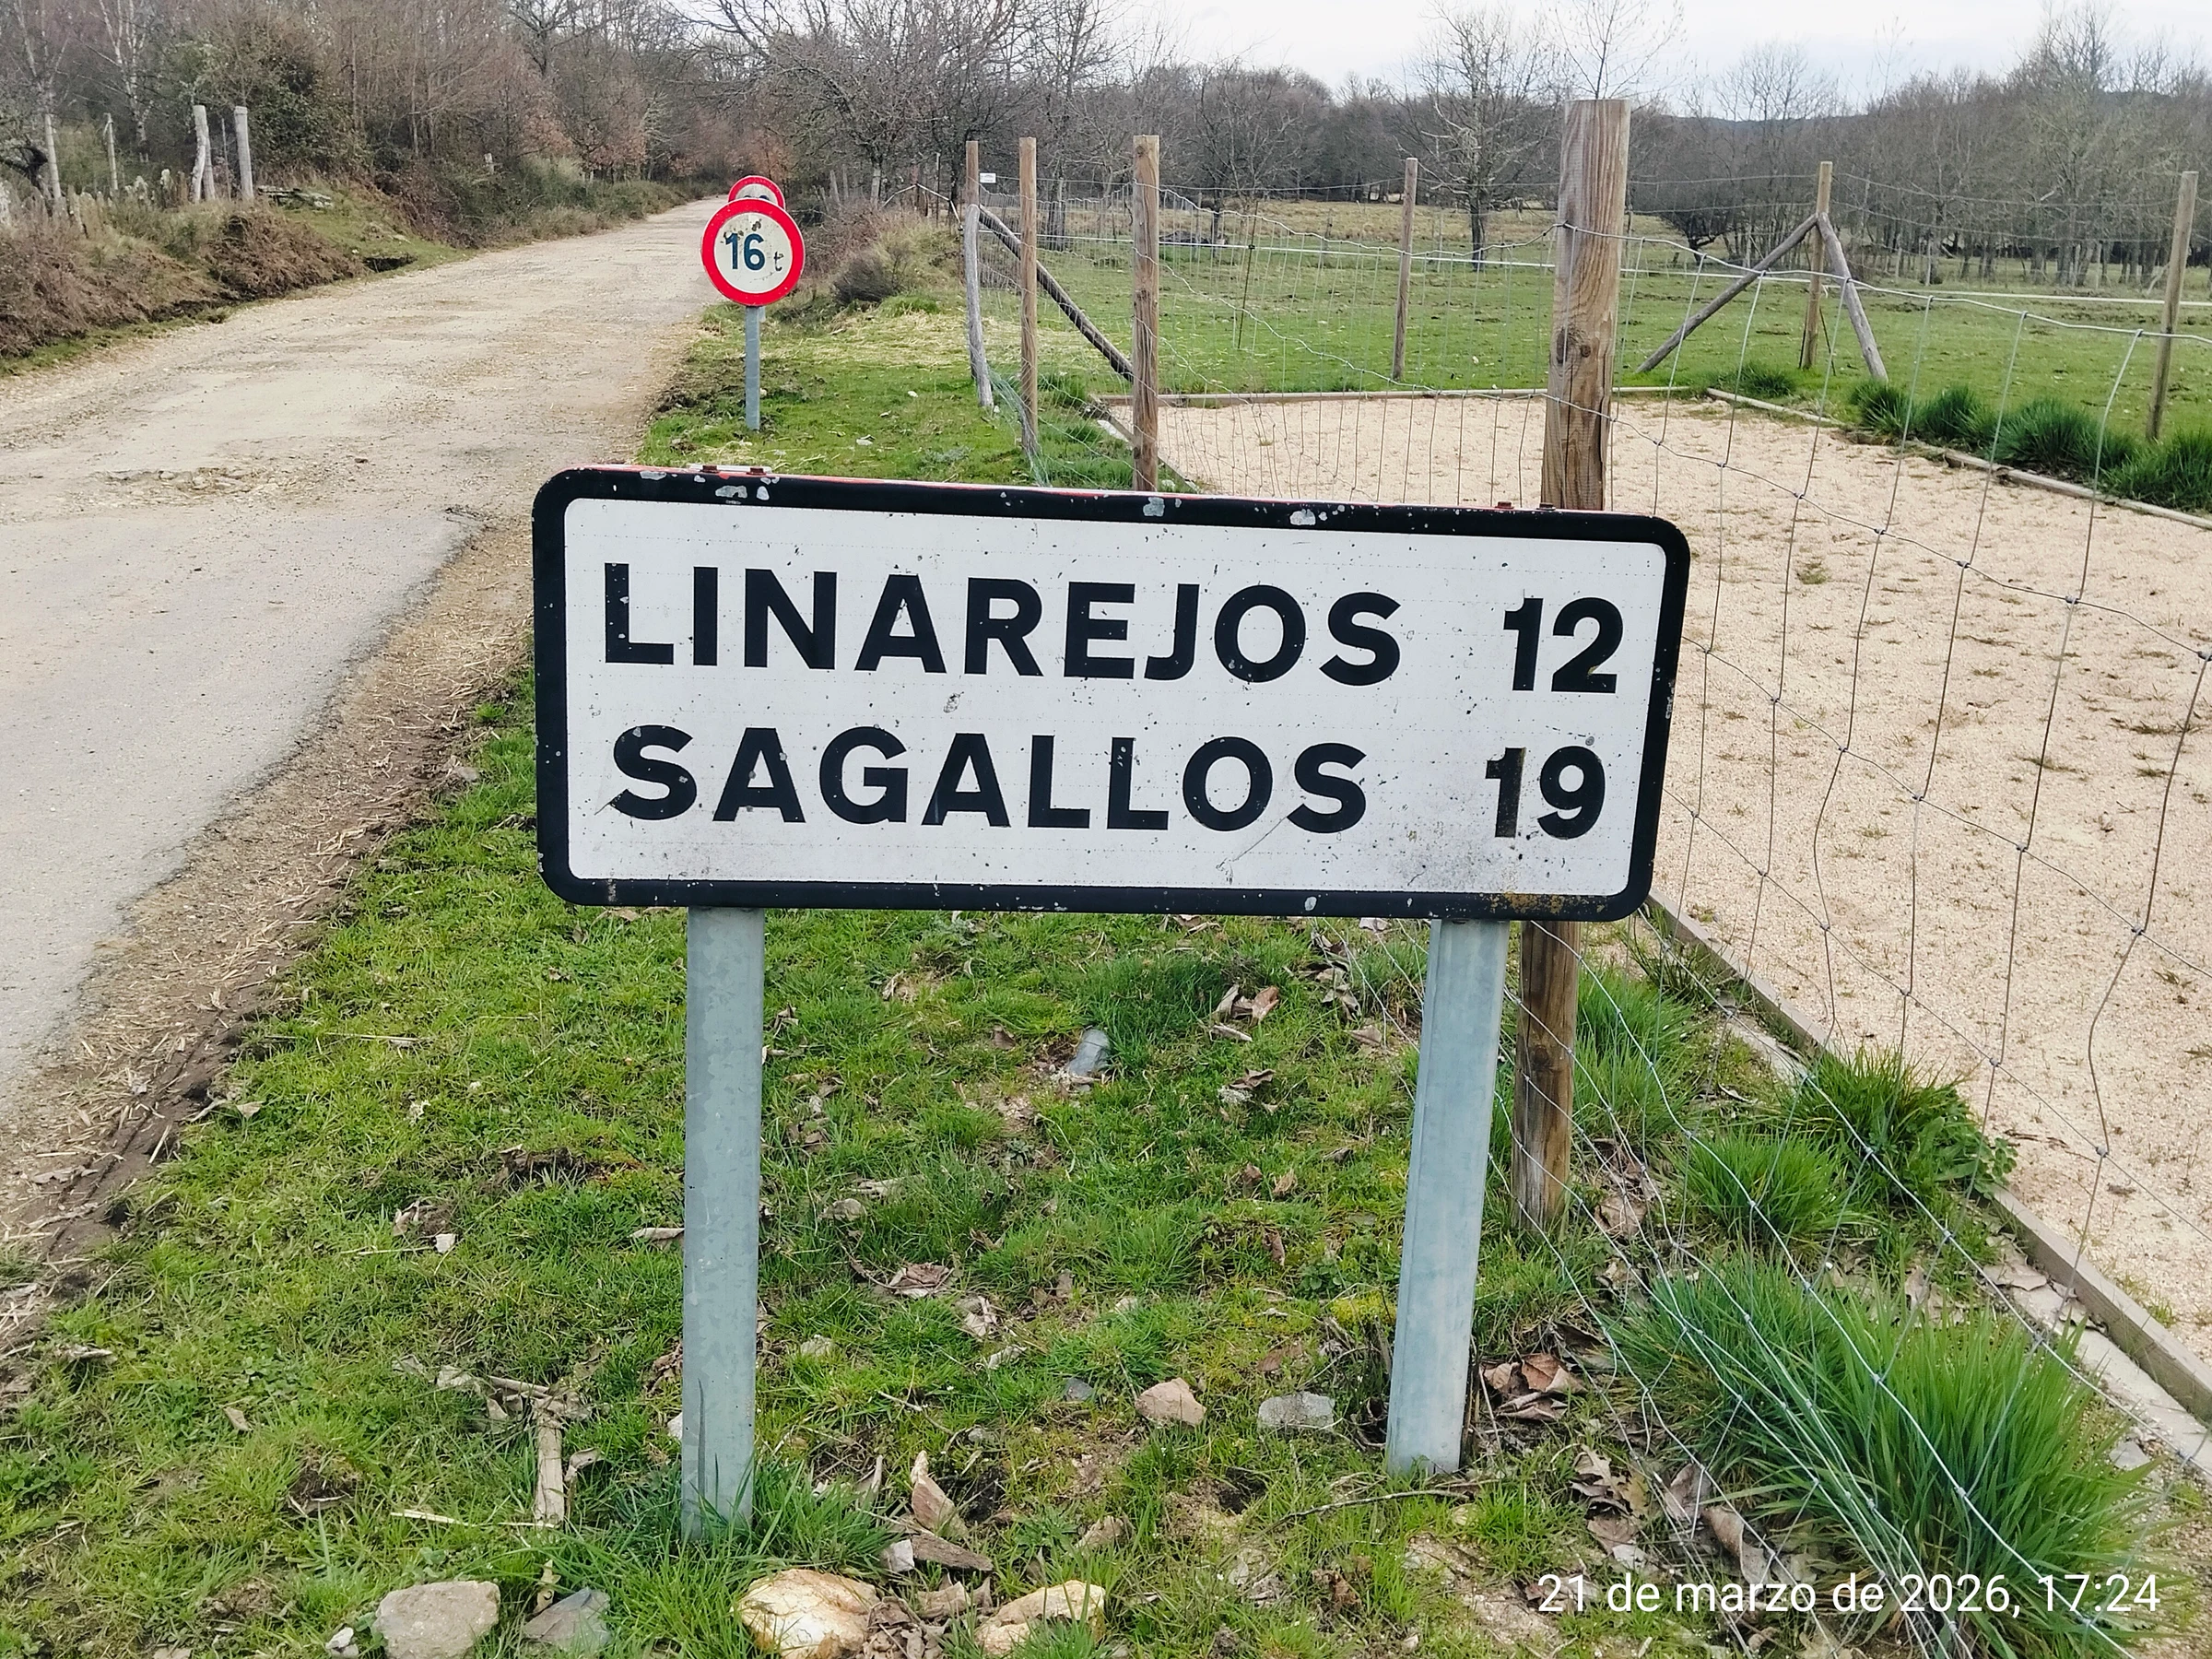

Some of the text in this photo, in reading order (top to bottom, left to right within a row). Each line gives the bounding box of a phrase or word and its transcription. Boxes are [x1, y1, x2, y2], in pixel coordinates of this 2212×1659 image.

[725, 233, 765, 271] 16
[605, 562, 1624, 693] LINAREJOS 12
[609, 724, 1606, 838] SAGALLOS 19
